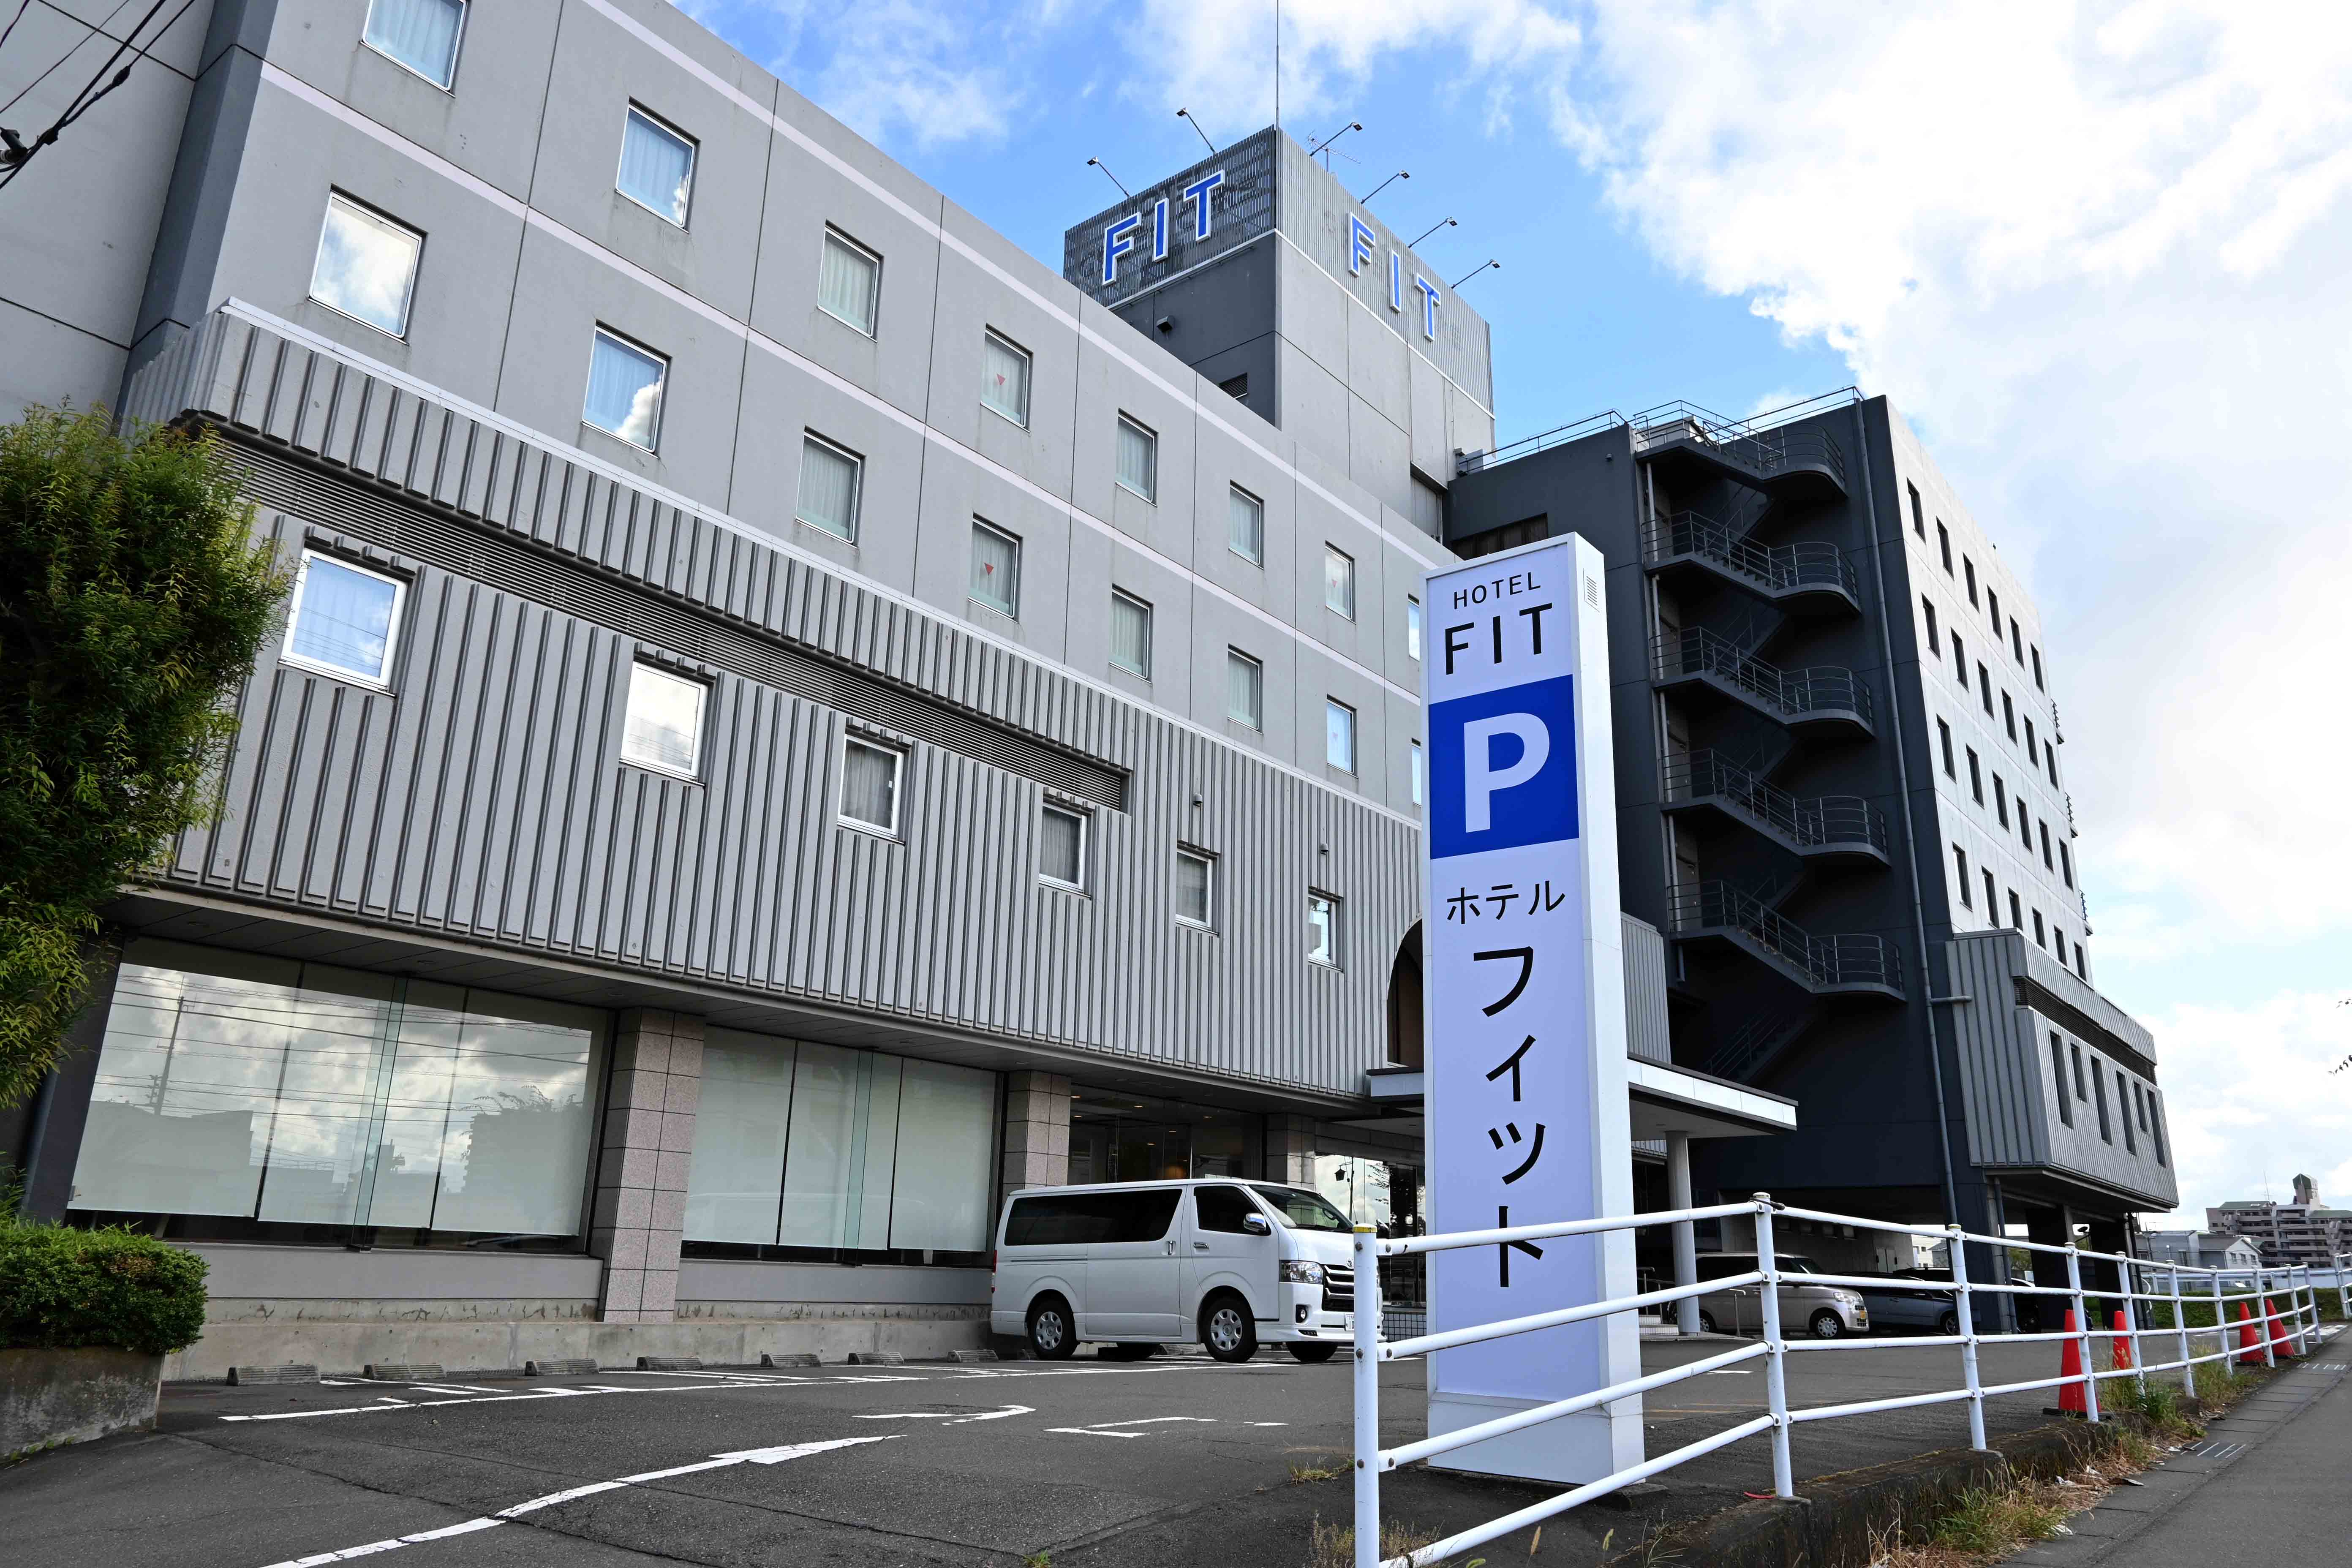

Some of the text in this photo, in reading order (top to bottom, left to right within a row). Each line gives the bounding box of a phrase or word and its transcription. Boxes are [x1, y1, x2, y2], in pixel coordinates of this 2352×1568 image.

[1102, 169, 1225, 287] FIT
[1347, 211, 1441, 342] FIT
[1445, 602, 1553, 675] FIT
[1454, 572, 1541, 610] HOTEL
[1463, 712, 1550, 833] P
[1446, 880, 1565, 925] ホテル
[1473, 945, 1546, 1288] フィット
